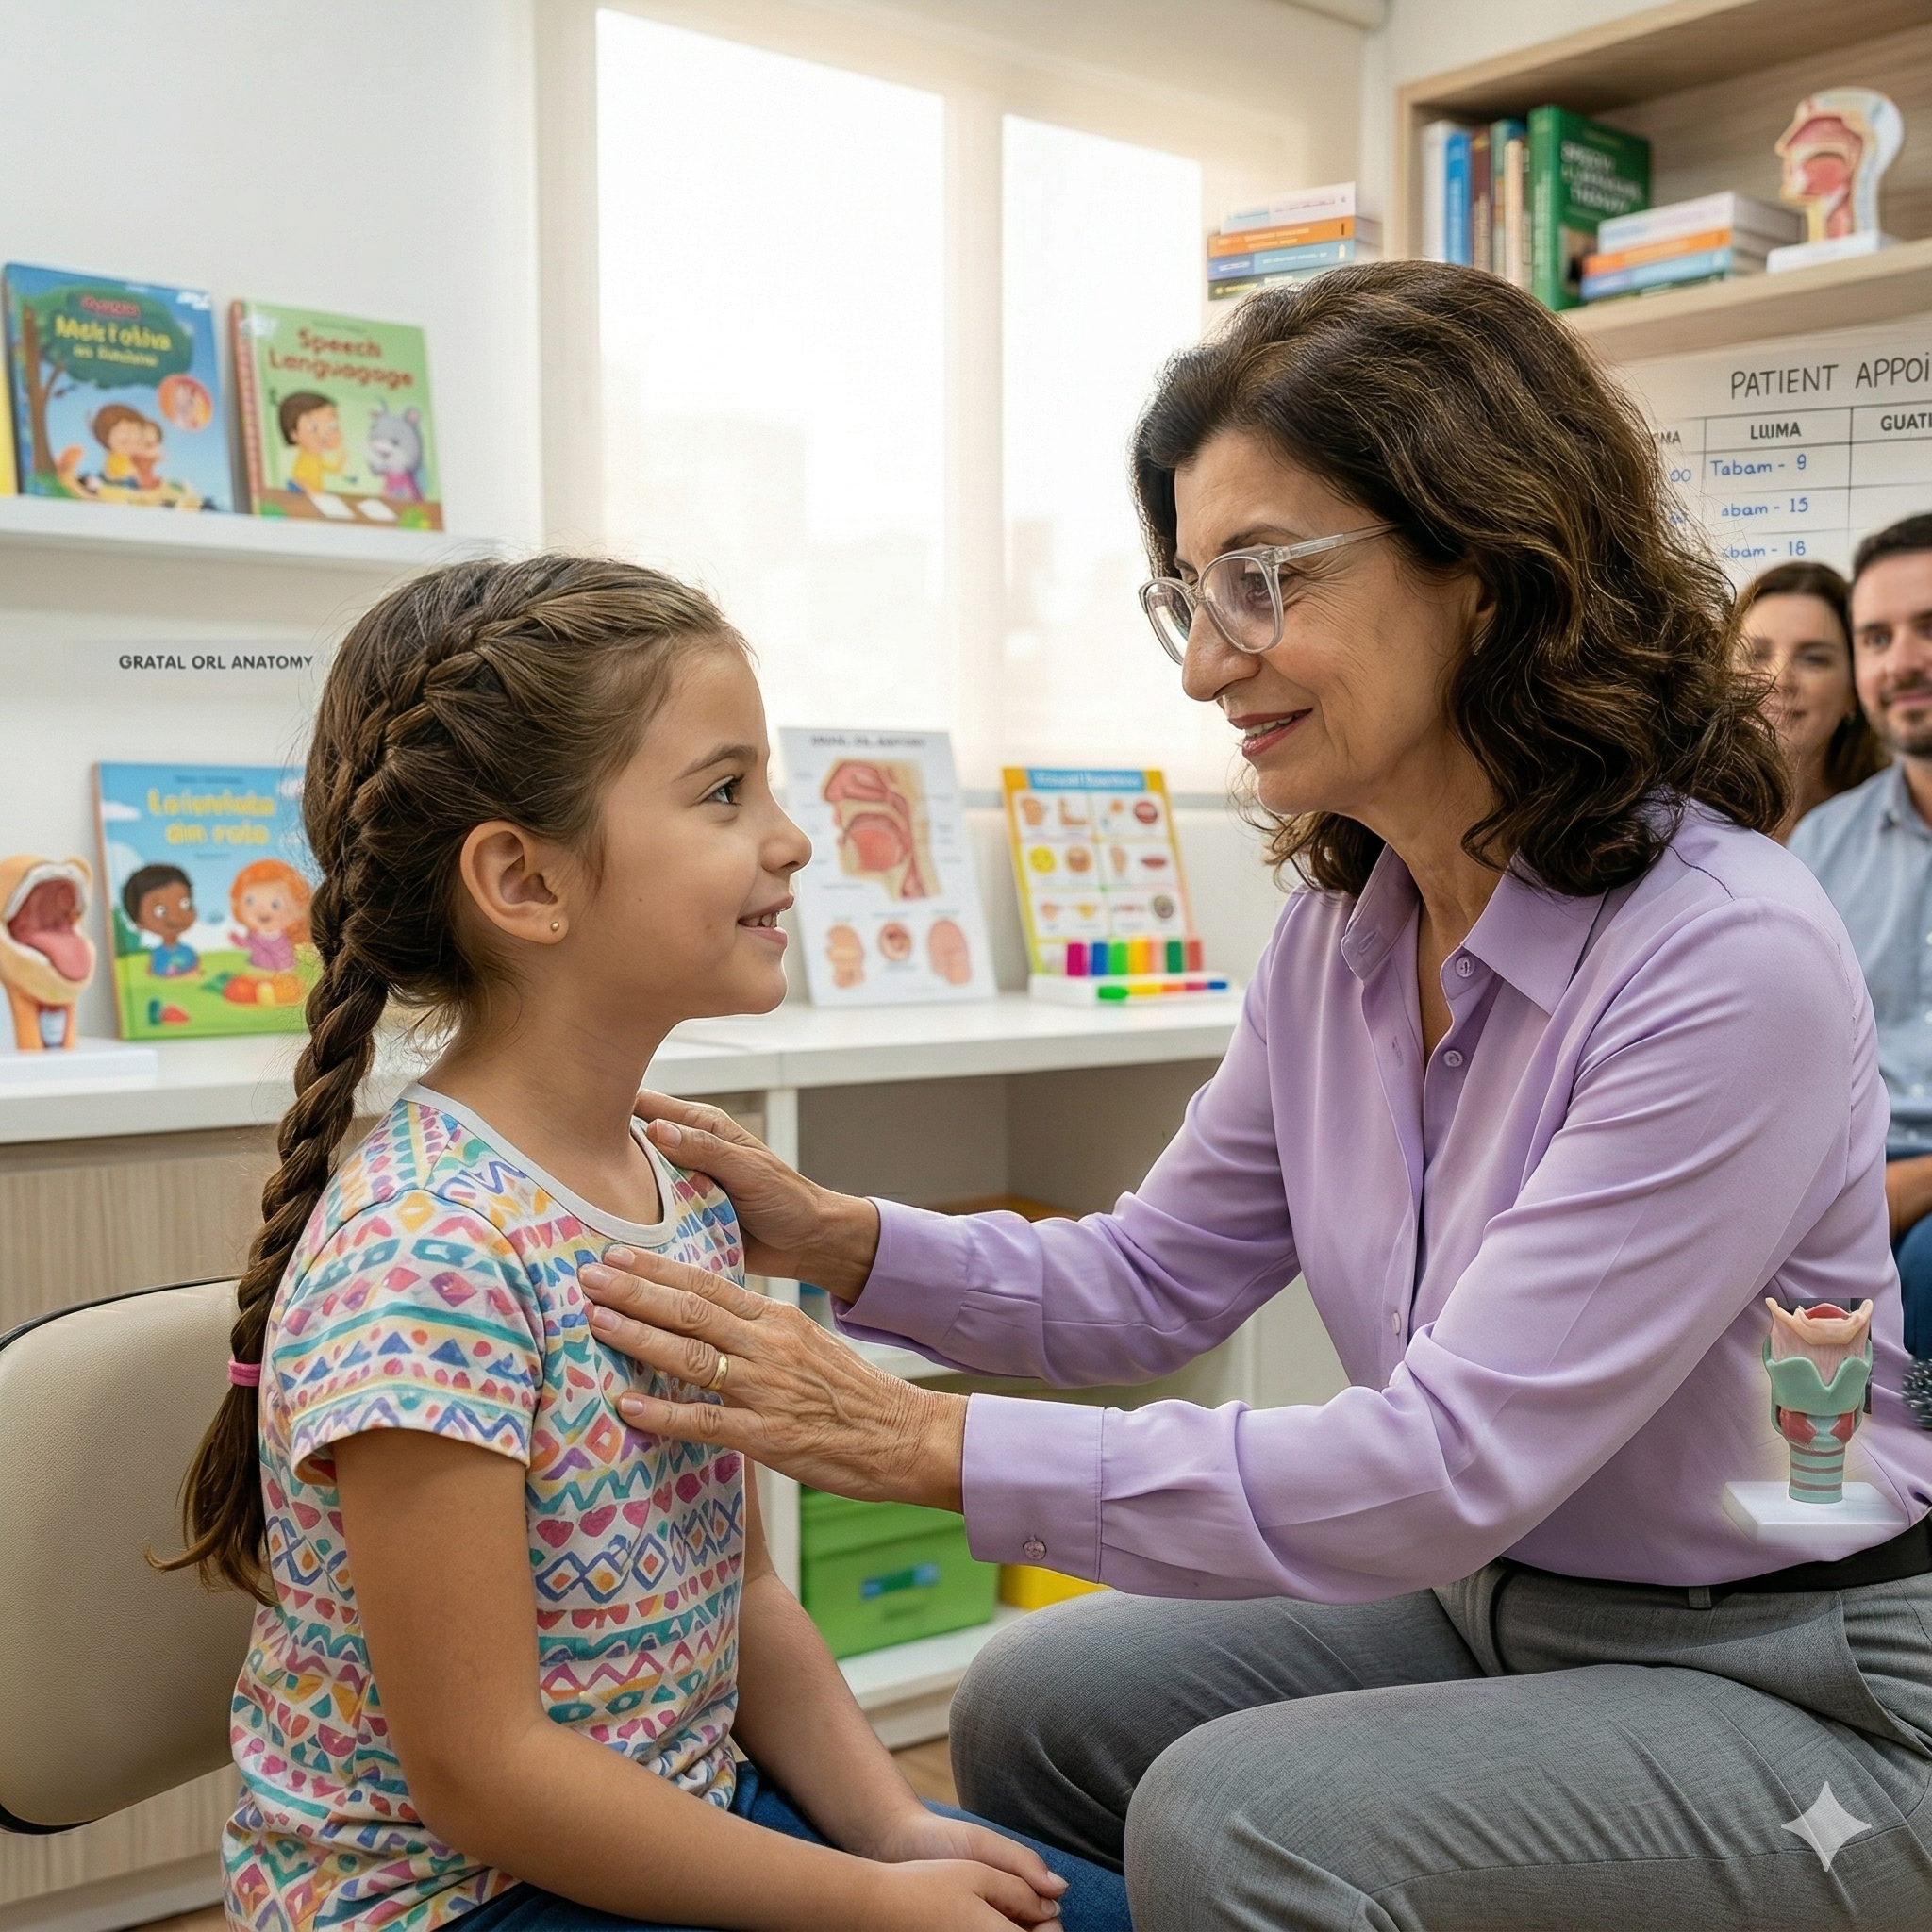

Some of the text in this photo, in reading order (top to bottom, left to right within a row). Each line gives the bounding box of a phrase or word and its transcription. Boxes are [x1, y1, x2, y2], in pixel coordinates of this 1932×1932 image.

[1731, 364, 1839, 400] PATIENT
[1710, 458, 1773, 476] Tabam
[118, 655, 314, 671] GRATAL ORL ANATOMY
